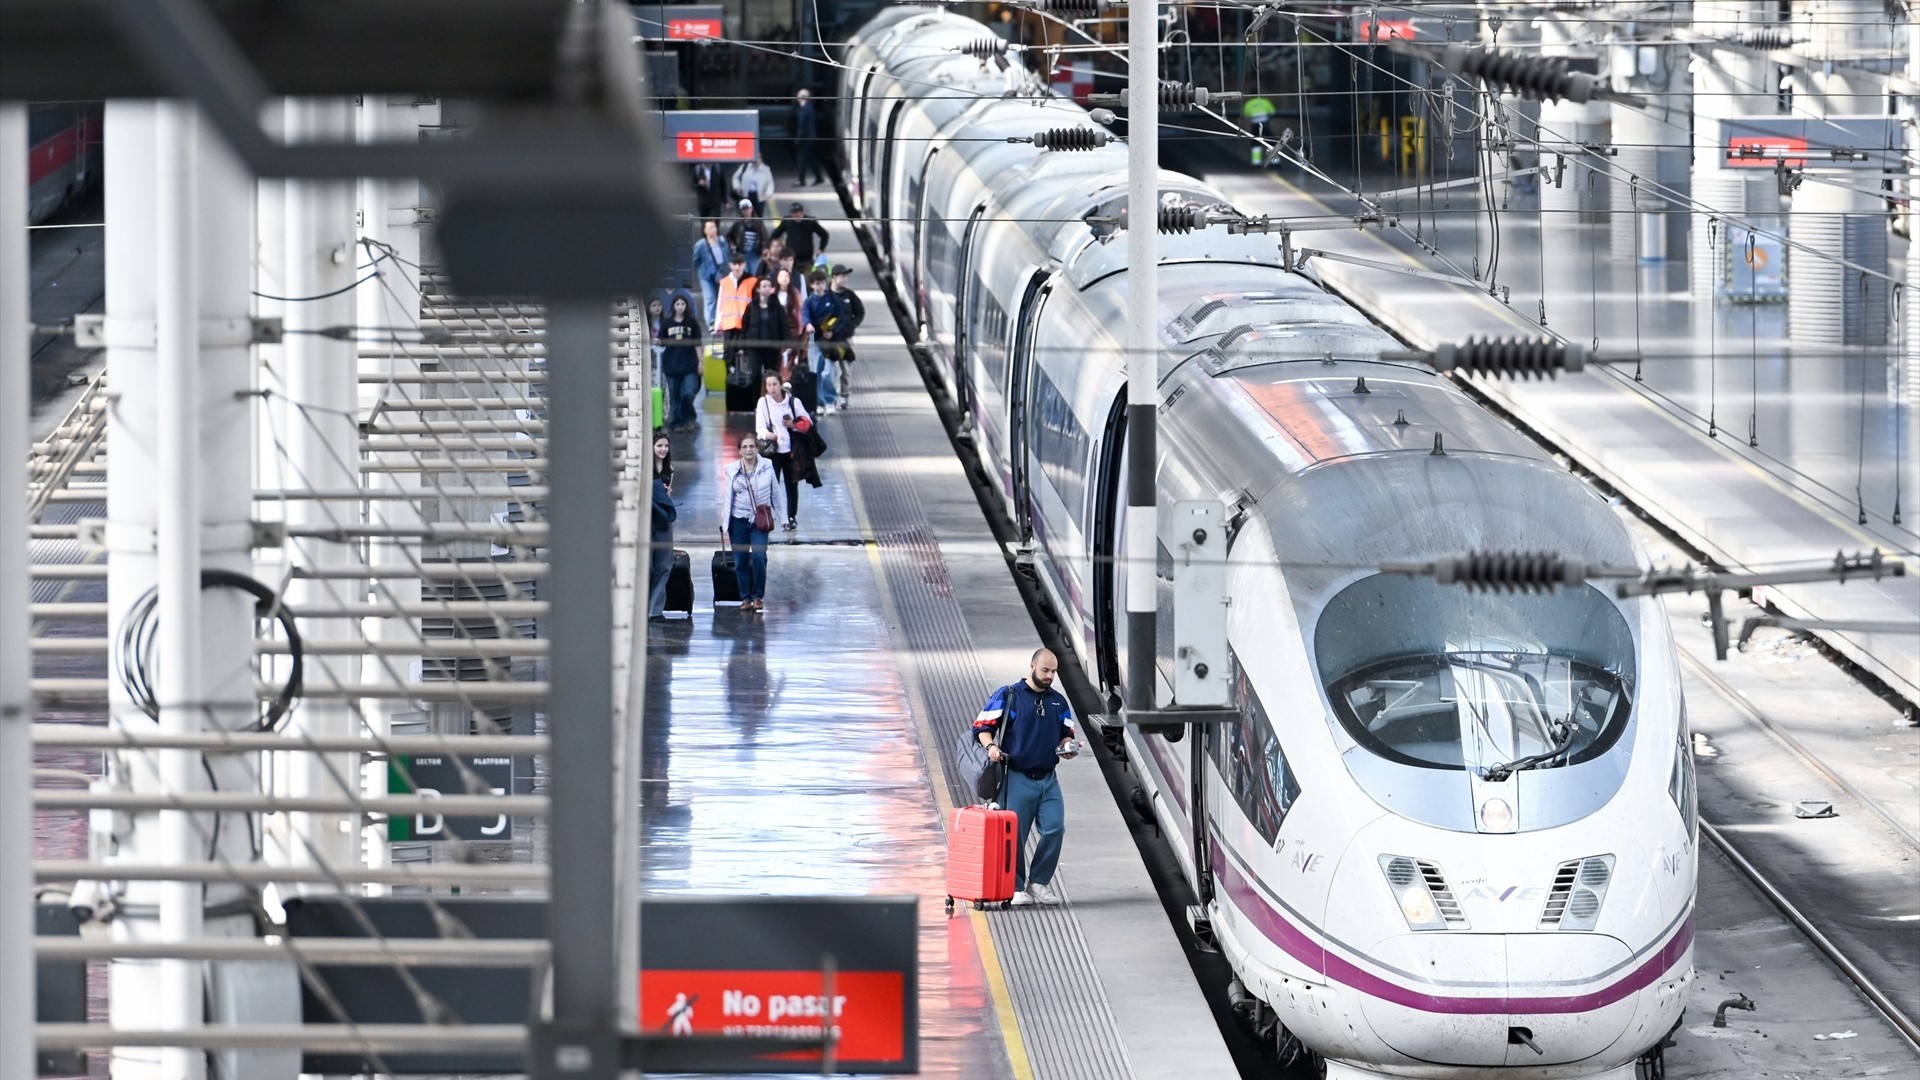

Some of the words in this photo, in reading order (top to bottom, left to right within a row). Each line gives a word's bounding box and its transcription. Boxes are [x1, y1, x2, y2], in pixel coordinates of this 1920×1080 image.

[1291, 851, 1324, 873] AVE
[1663, 851, 1681, 876] AVE
[1463, 886, 1545, 902] AVE
[722, 990, 761, 1017] No
[768, 994, 847, 1022] pasar
